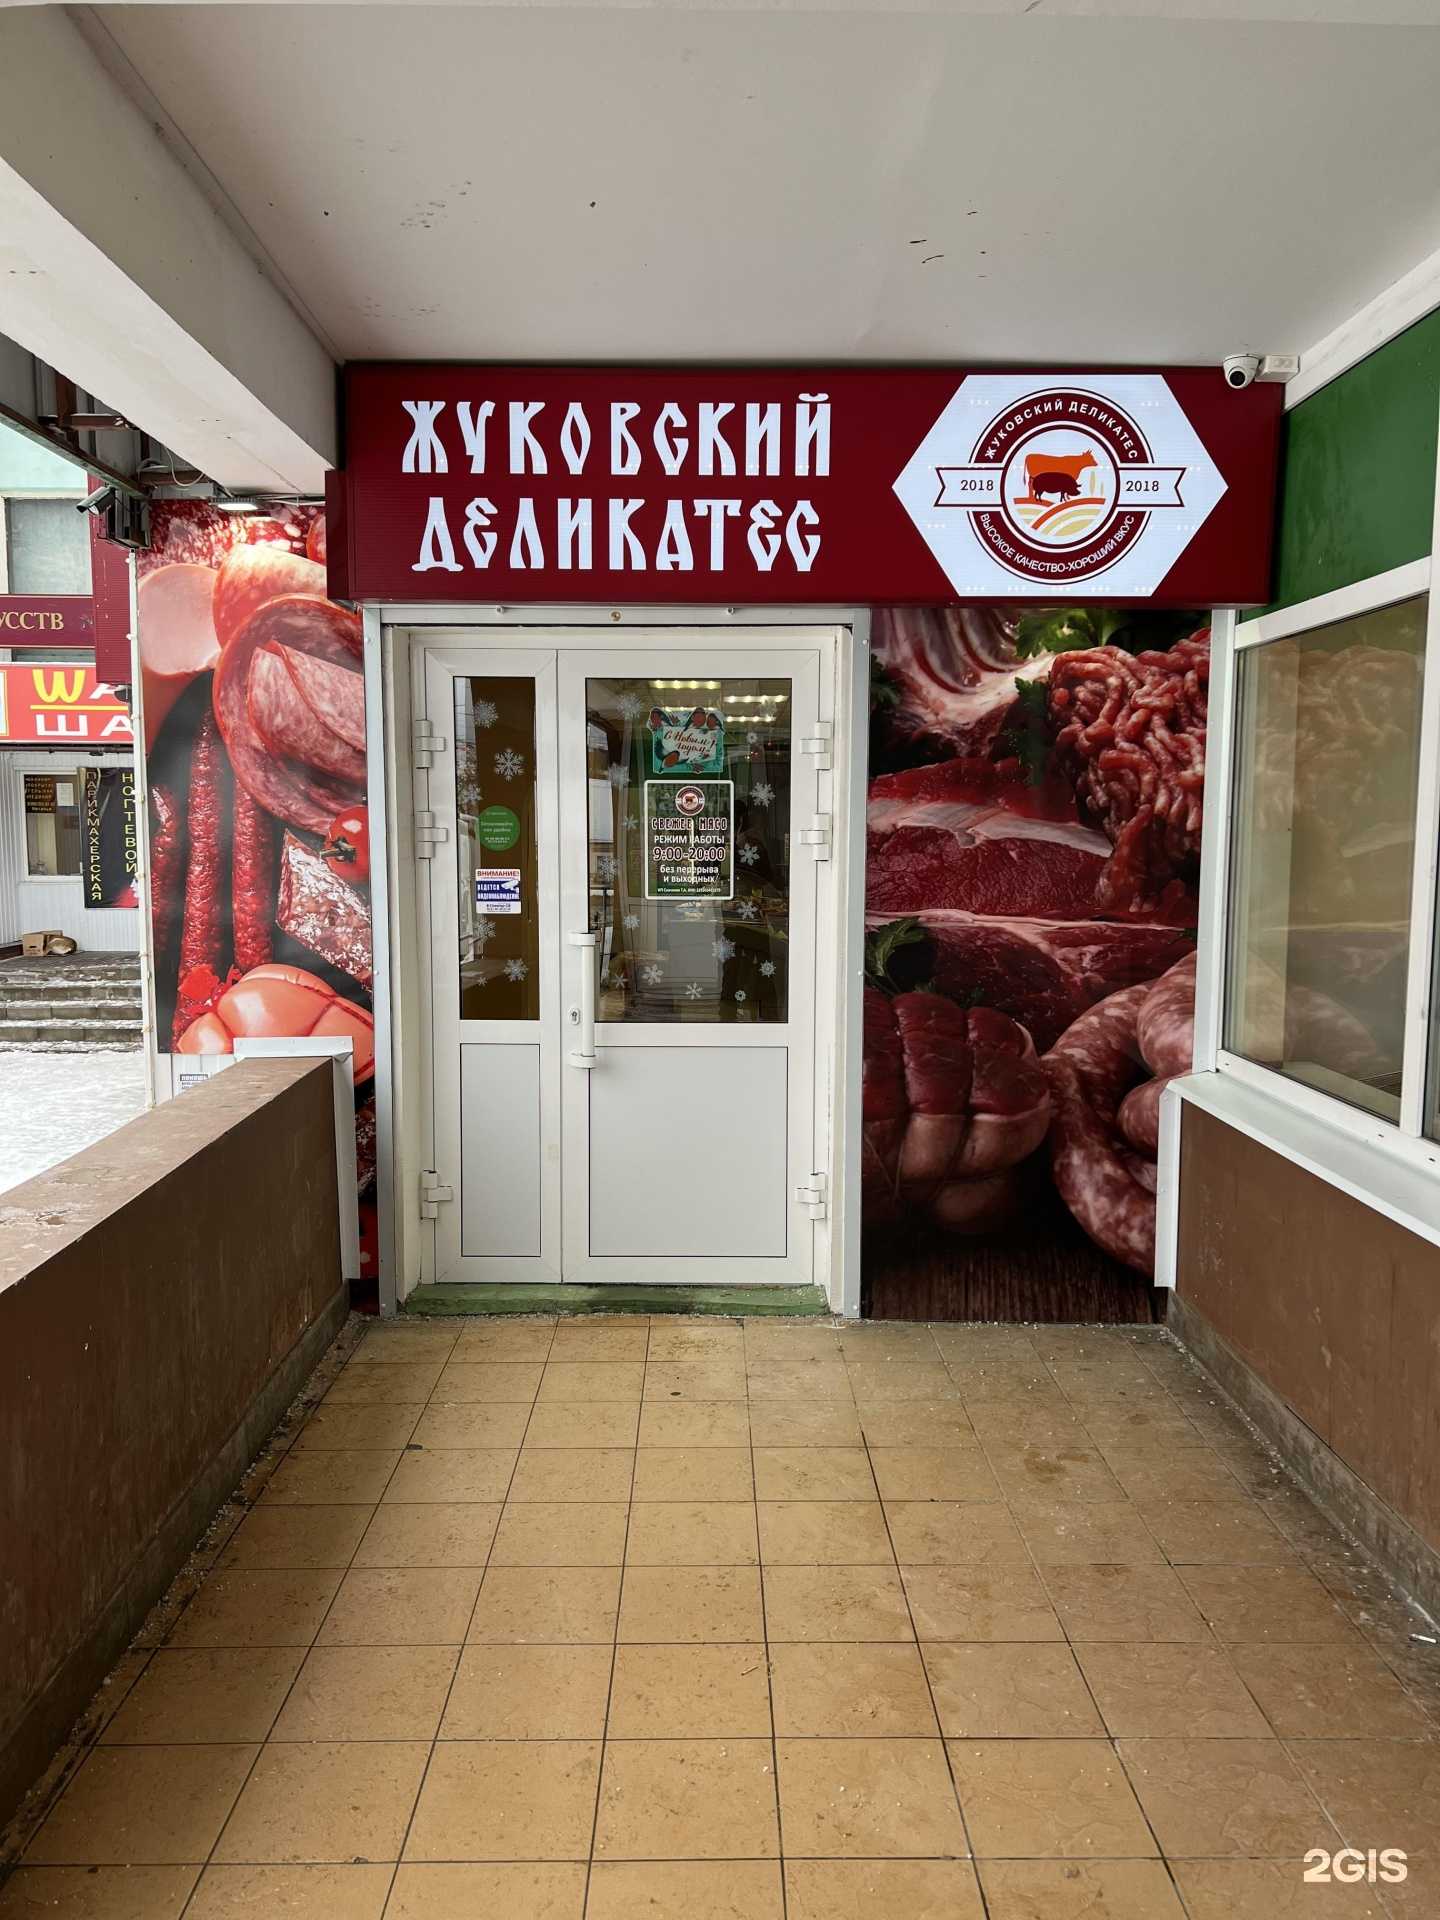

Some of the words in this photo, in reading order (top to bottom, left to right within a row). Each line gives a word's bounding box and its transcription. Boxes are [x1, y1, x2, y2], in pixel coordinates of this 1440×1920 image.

[401, 393, 831, 476] ЖУКОВСКИЙ
[985, 399, 1064, 460] ЖУКОВСКИЙ
[1069, 400, 1138, 459] ДЕЛИКАТЕС
[960, 480, 994, 491] 2018
[1126, 480, 1160, 492] 2018
[411, 497, 821, 572] ДЕЛИКАТЕС
[980, 513, 1014, 558] ВЫСОКОЕ
[1114, 514, 1135, 542] ВКУС
[86, 771, 102, 900] ПАРИКМАХЕРСКАЯ
[121, 773, 138, 873] НОГТЕВОЙ
[651, 817, 692, 830] СВЕЖЕЕ
[699, 817, 728, 831] МЯСО
[654, 835, 687, 844] РЕЖИМ
[660, 864, 675, 873] без
[676, 866, 719, 876] перерыва
[671, 875, 715, 885] выходных
